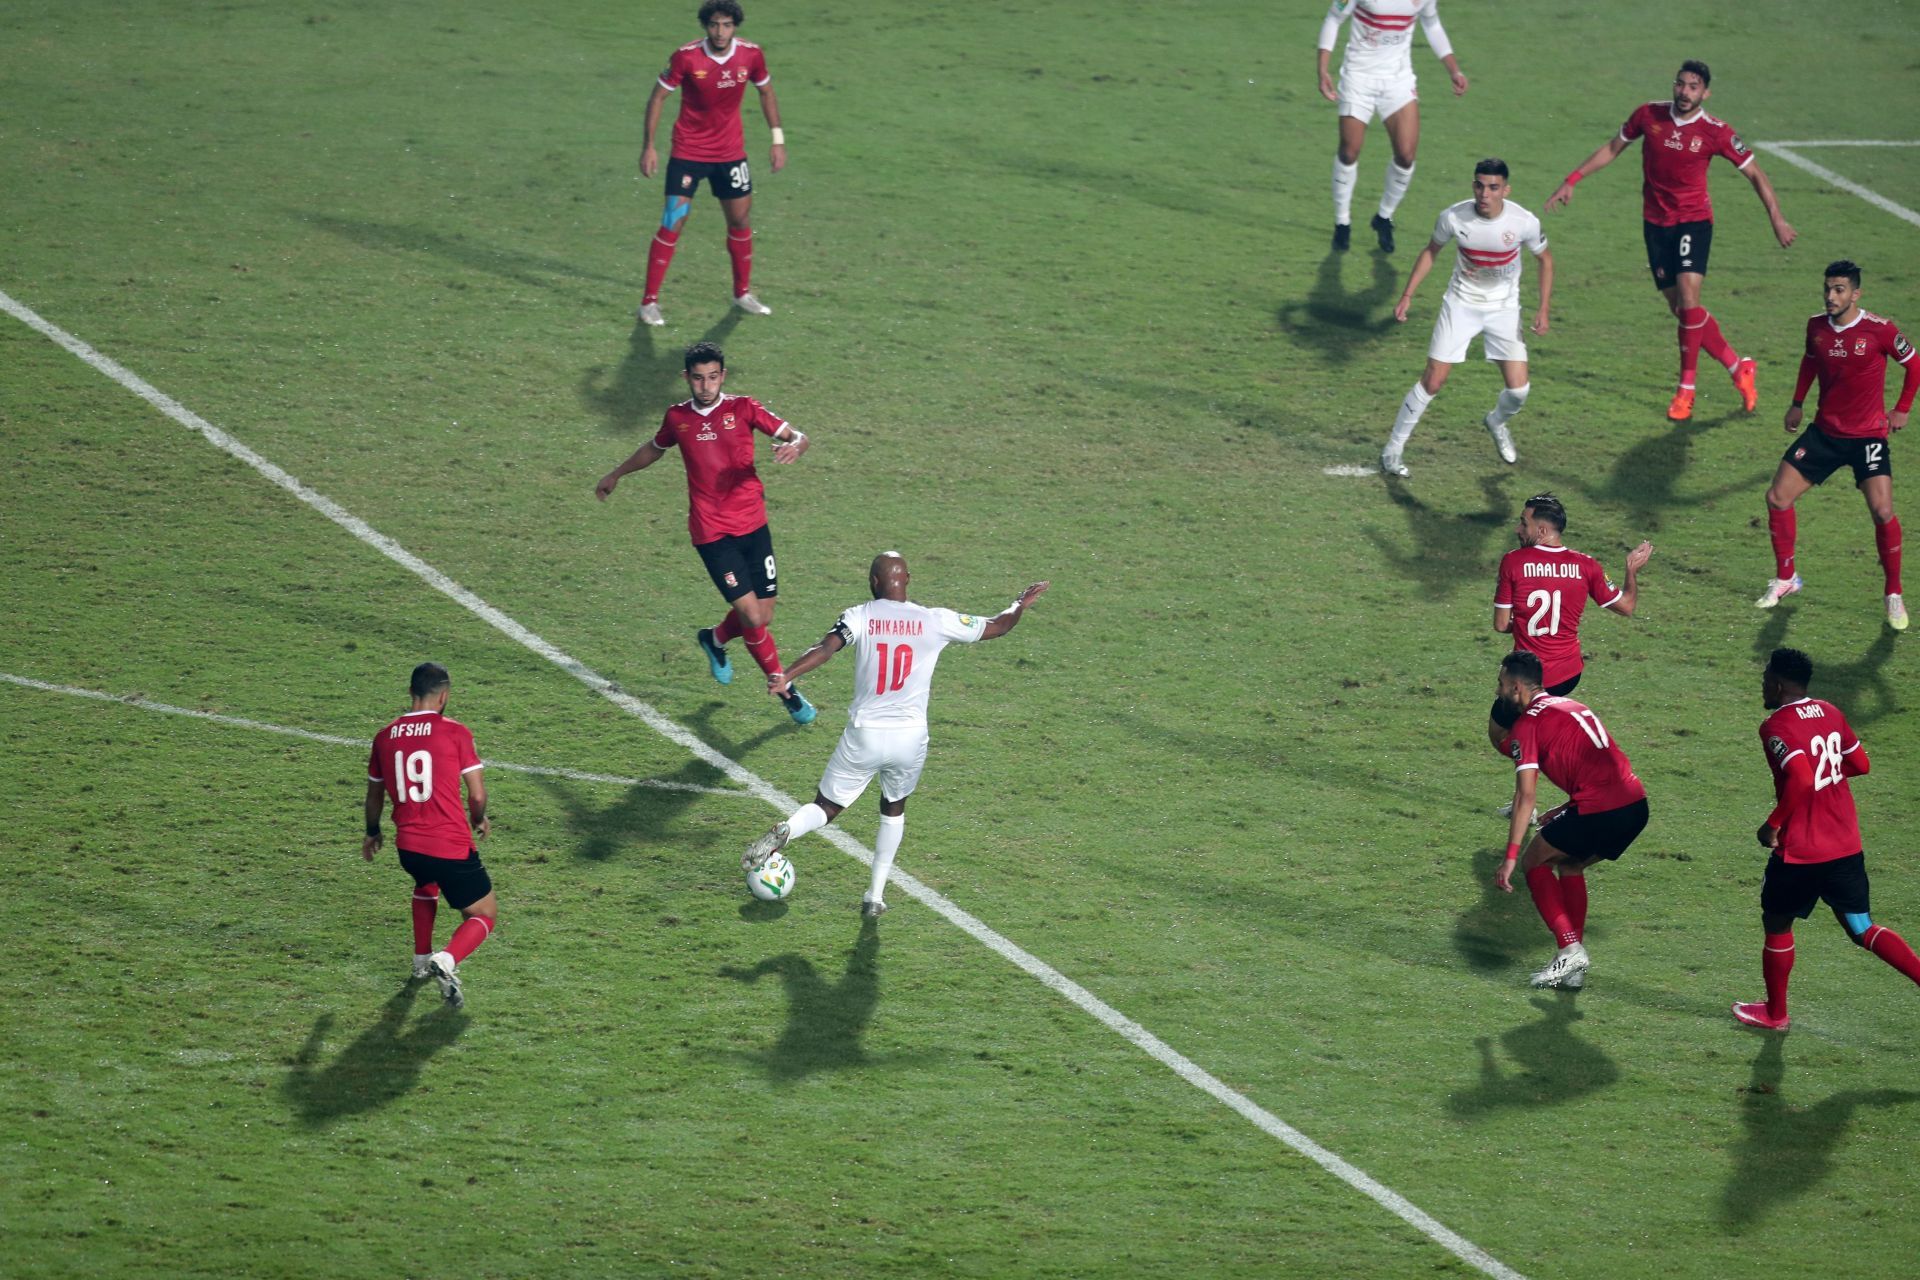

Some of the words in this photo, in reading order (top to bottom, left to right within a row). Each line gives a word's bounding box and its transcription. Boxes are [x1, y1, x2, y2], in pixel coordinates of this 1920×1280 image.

[729, 161, 749, 188] 30
[1679, 234, 1692, 256] 6
[1865, 443, 1882, 464] 12
[764, 555, 777, 580] 8
[1523, 562, 1582, 579] MAALOUL
[1526, 589, 1561, 637] 21
[868, 619, 923, 635] SHIKABALA
[876, 643, 913, 695] 10
[390, 722, 432, 739] AFSHA
[1570, 709, 1609, 749] 17
[1810, 731, 1844, 791] 28
[394, 750, 433, 803] 19
